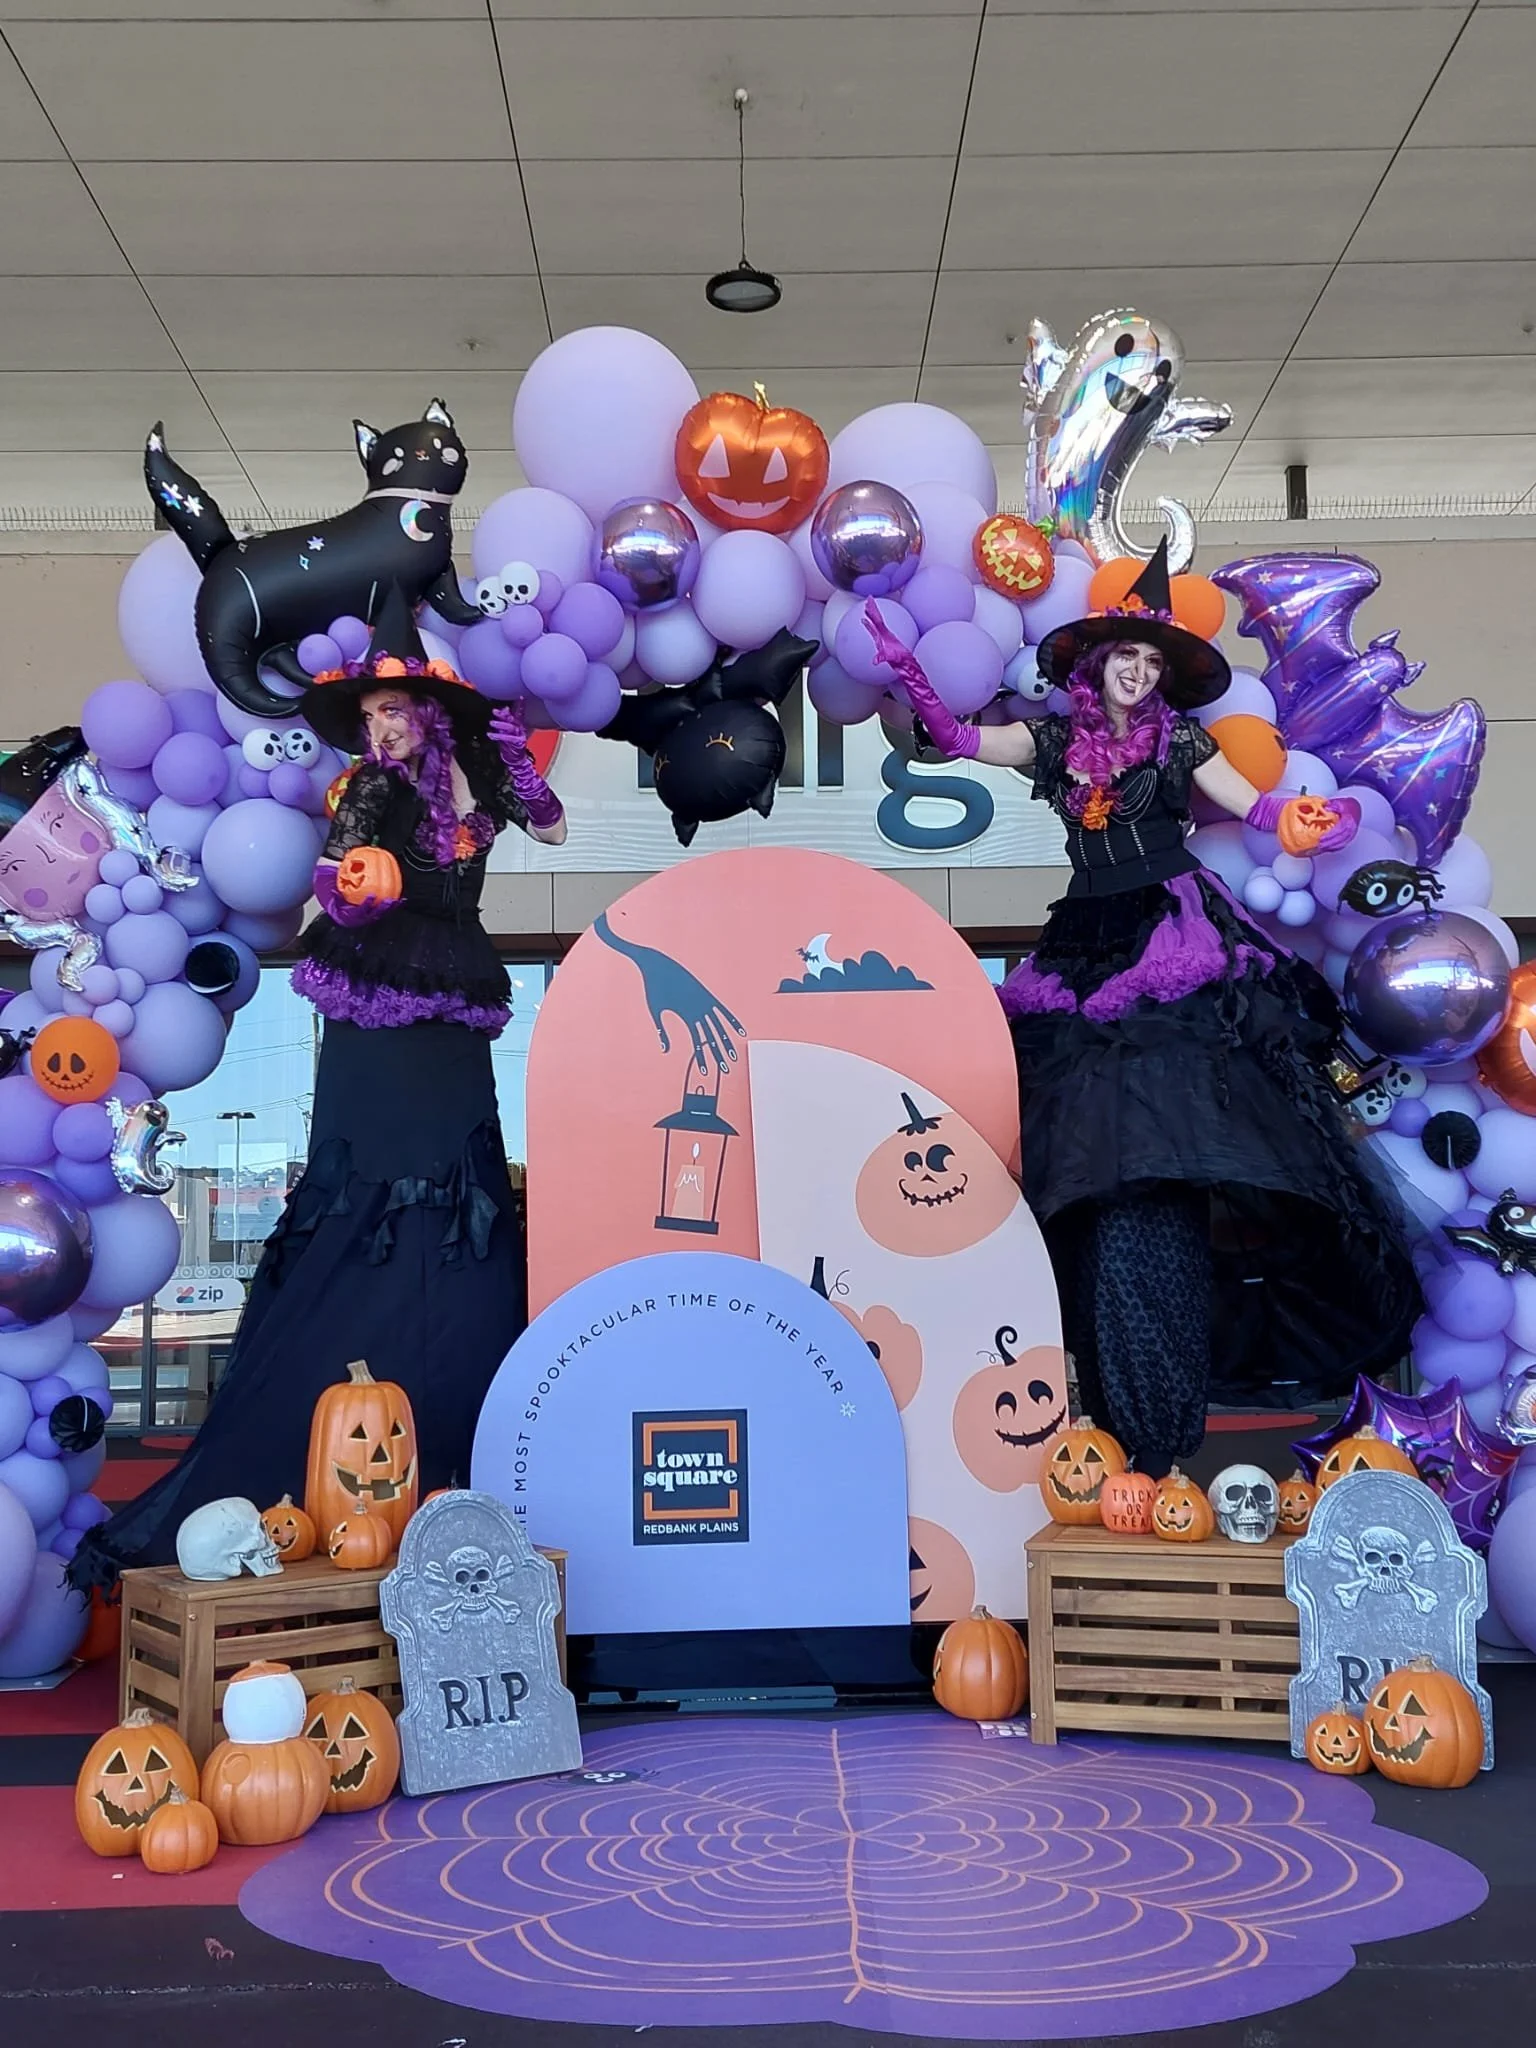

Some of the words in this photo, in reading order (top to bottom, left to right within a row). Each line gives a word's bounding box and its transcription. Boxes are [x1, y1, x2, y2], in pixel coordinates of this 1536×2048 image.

[198, 1285, 224, 1303] zip
[514, 1432, 531, 1492] MOST
[525, 1299, 656, 1422] SPOOKTACULAR
[667, 1294, 718, 1307] TIME
[728, 1298, 756, 1315] OF
[765, 1311, 801, 1342] THE
[805, 1342, 844, 1394] YEAR
[656, 1448, 724, 1468] town
[643, 1469, 738, 1492] square
[1112, 1488, 1153, 1503] TRICK
[1126, 1503, 1142, 1516] OR
[643, 1523, 697, 1535] REDBANK
[699, 1522, 739, 1534] PLAINS
[439, 1671, 530, 1729] R.I.P
